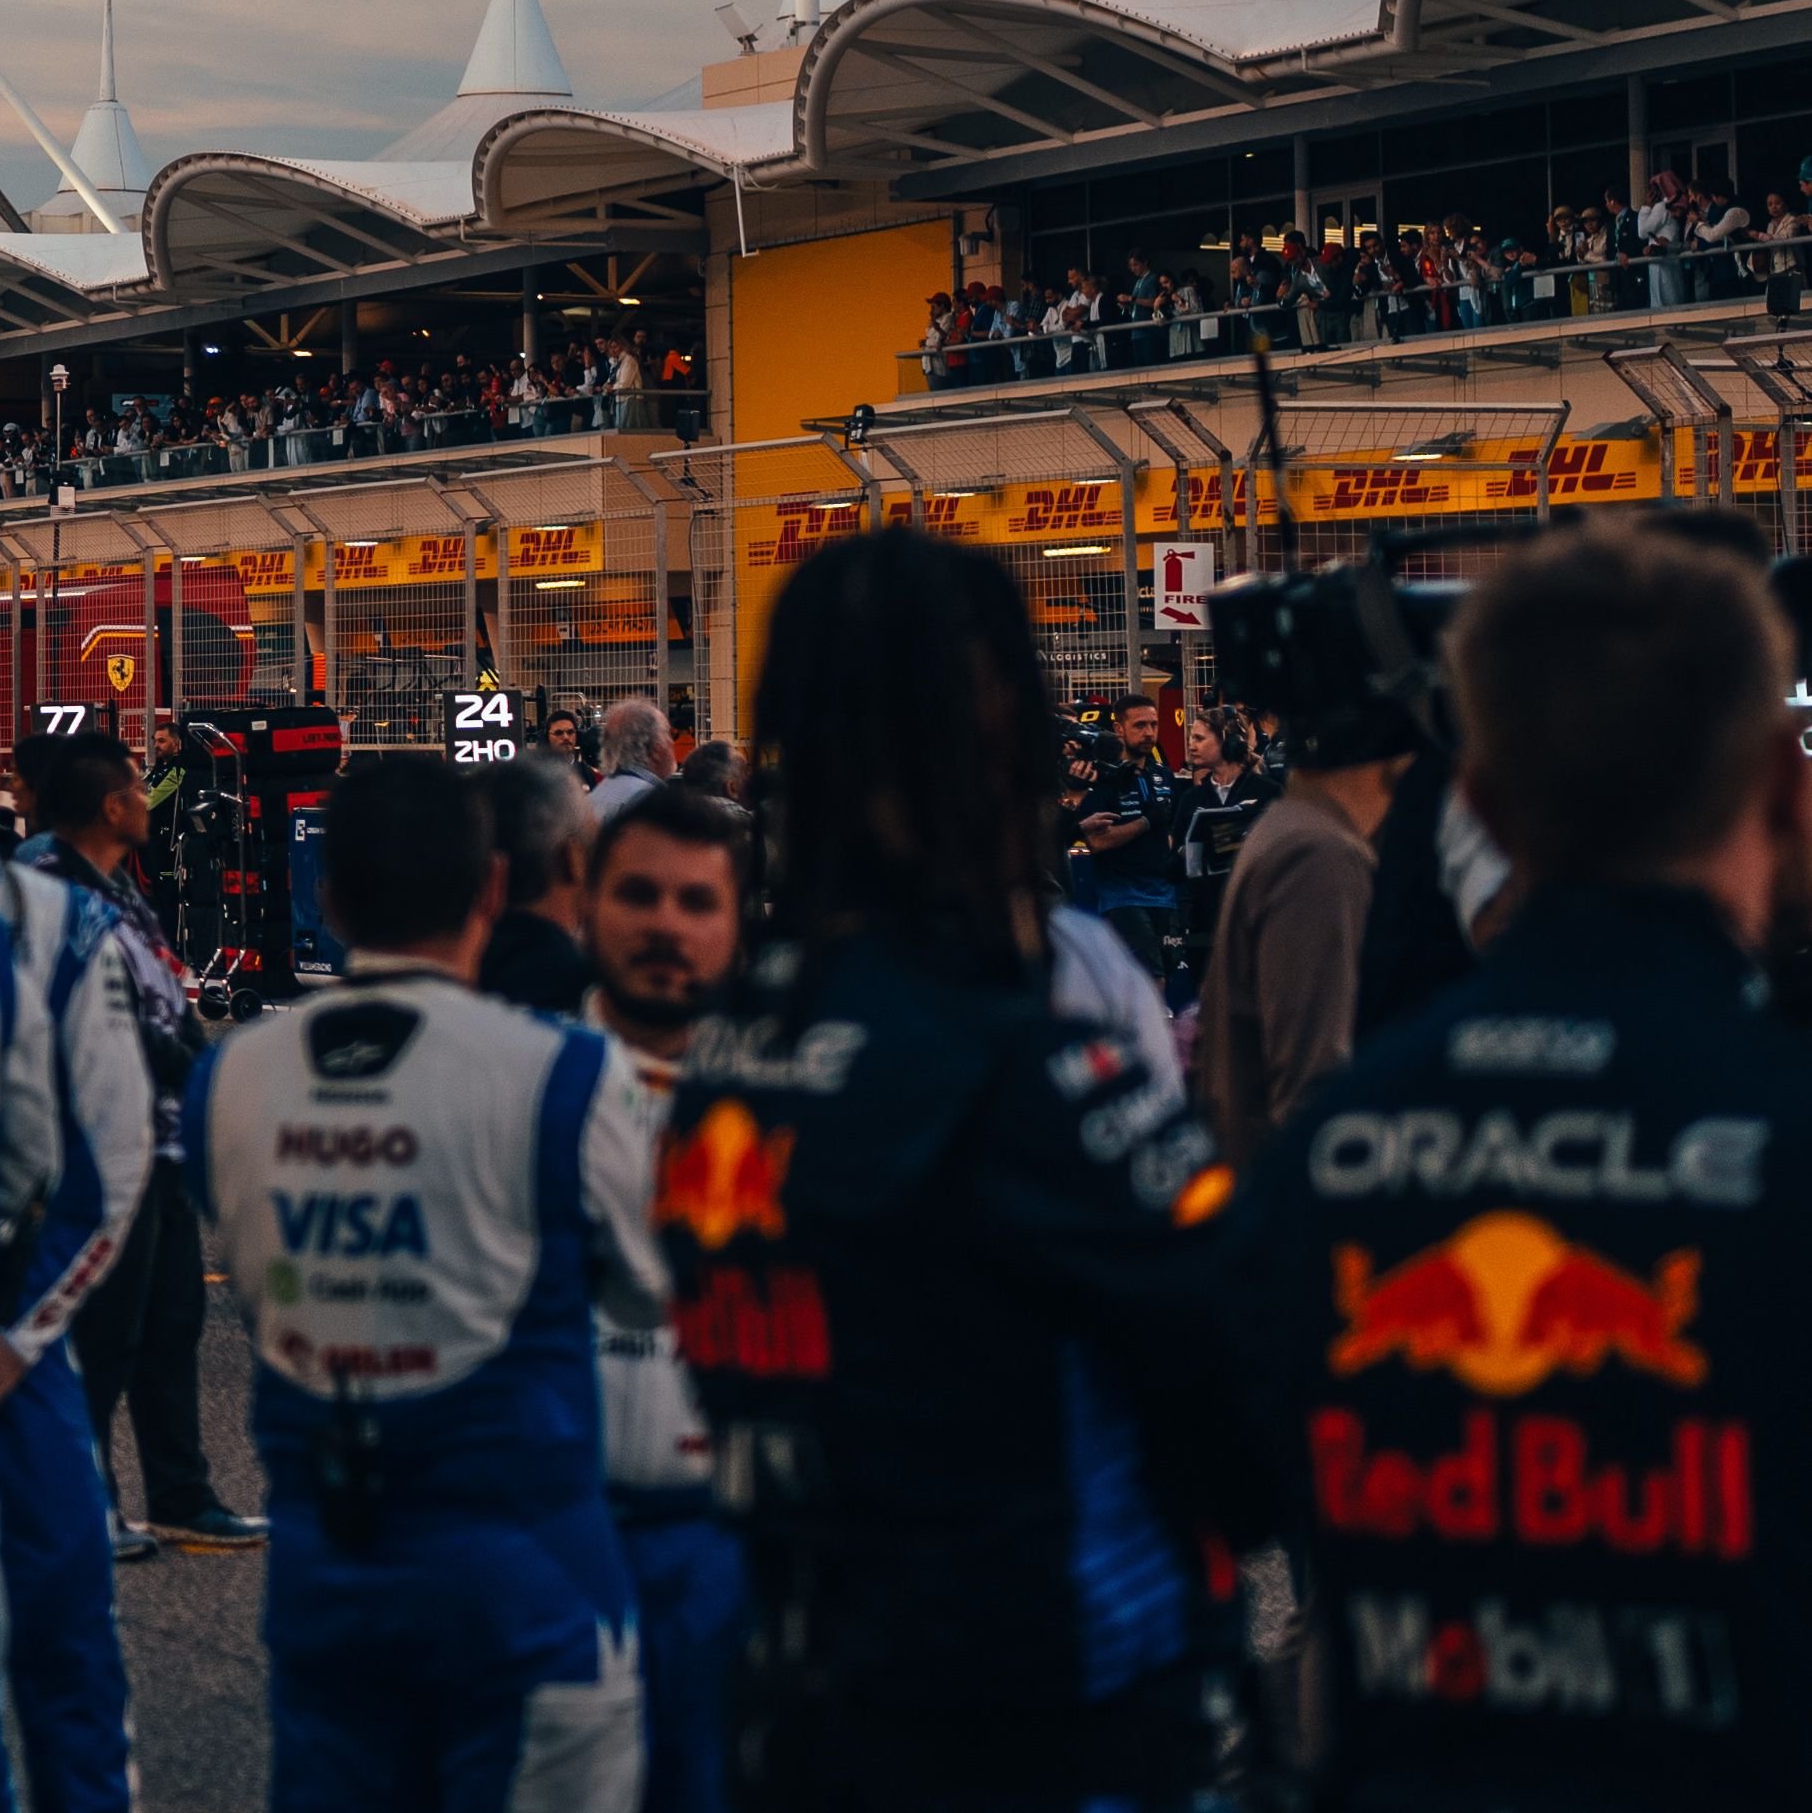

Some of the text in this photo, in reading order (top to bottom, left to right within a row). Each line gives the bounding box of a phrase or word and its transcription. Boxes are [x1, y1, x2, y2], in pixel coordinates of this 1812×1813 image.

[1506, 444, 1615, 496] DHL
[1331, 469, 1429, 509] DHL
[1023, 486, 1105, 532] DHL
[332, 546, 379, 578] DHL
[419, 538, 467, 574] DHL
[519, 528, 578, 567] DHL
[240, 553, 289, 586] DHL
[1165, 595, 1208, 604] FIRE
[1050, 652, 1107, 661] LOGISTICS
[39, 706, 85, 735] 77
[454, 693, 513, 728] 24
[454, 739, 516, 763] ZHO
[278, 1124, 418, 1167] HUGO
[1308, 1106, 1773, 1208] ORACLE
[273, 1191, 430, 1255] VISA
[1308, 1402, 1755, 1562] Red Bull
